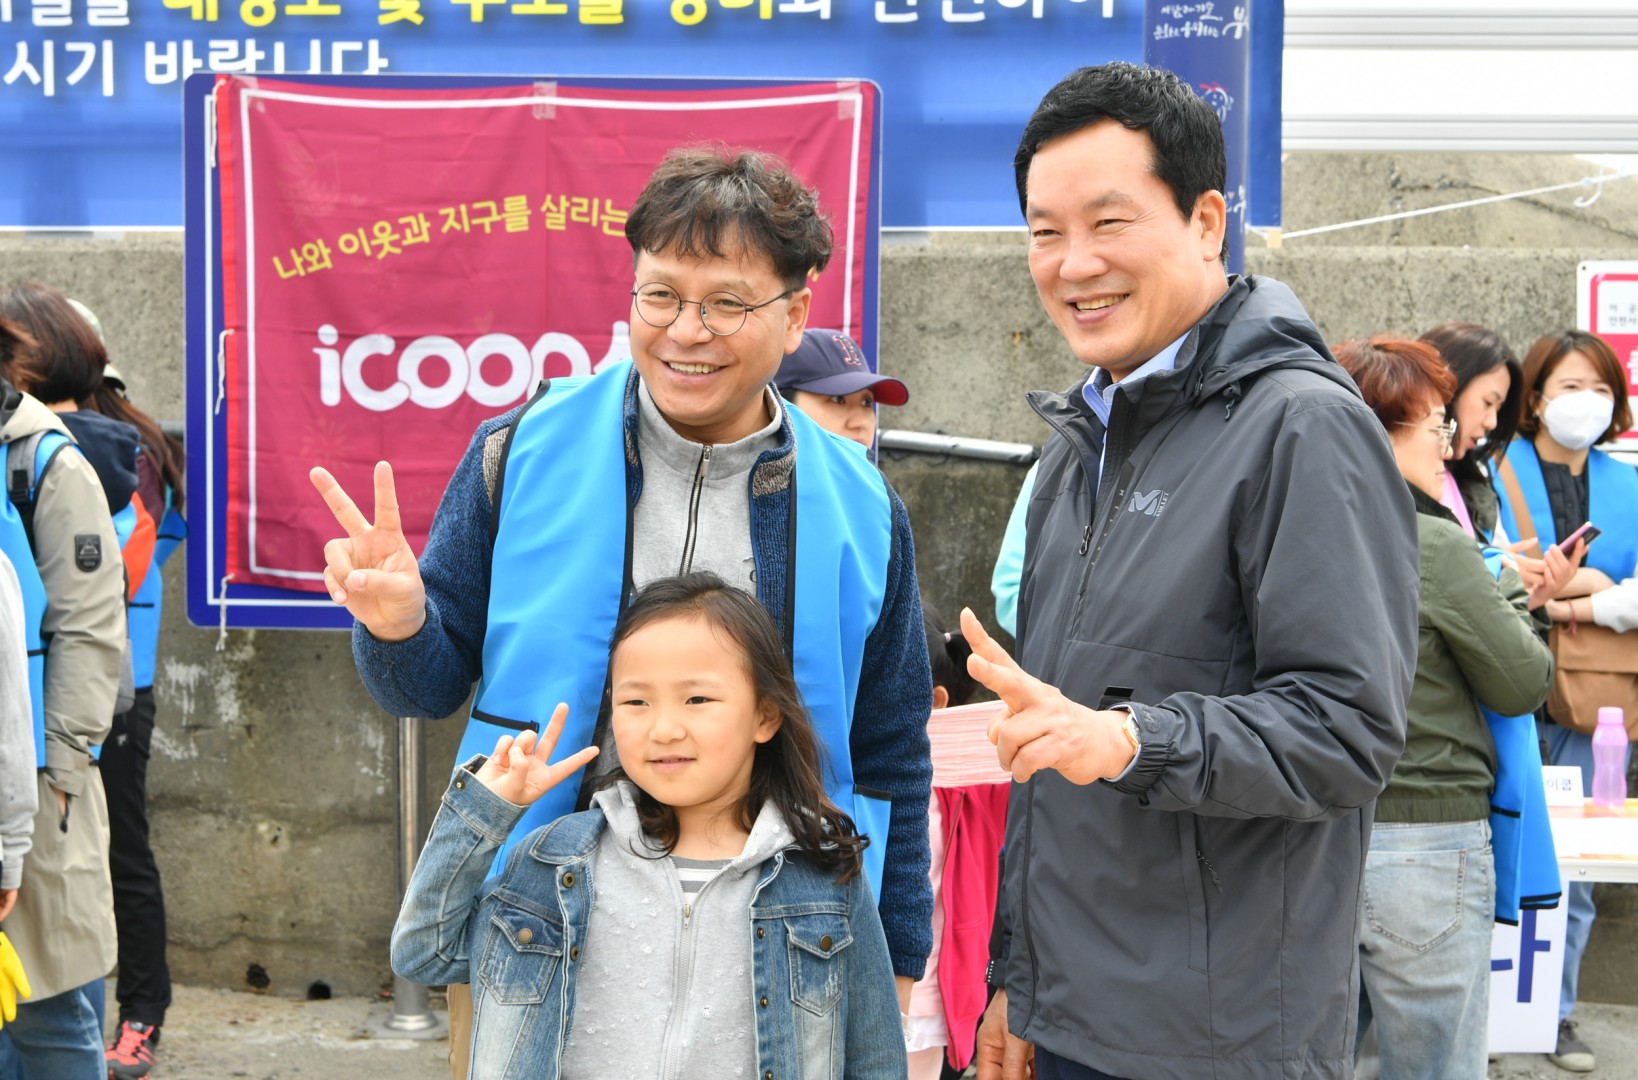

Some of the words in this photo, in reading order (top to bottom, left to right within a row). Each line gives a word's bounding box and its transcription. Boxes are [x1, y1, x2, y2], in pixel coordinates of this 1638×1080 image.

[3, 40, 114, 97] 시기
[272, 239, 333, 279] 나와
[338, 213, 431, 259] 이웃과
[439, 195, 532, 234] 지구를
[540, 194, 629, 237] 살리는
